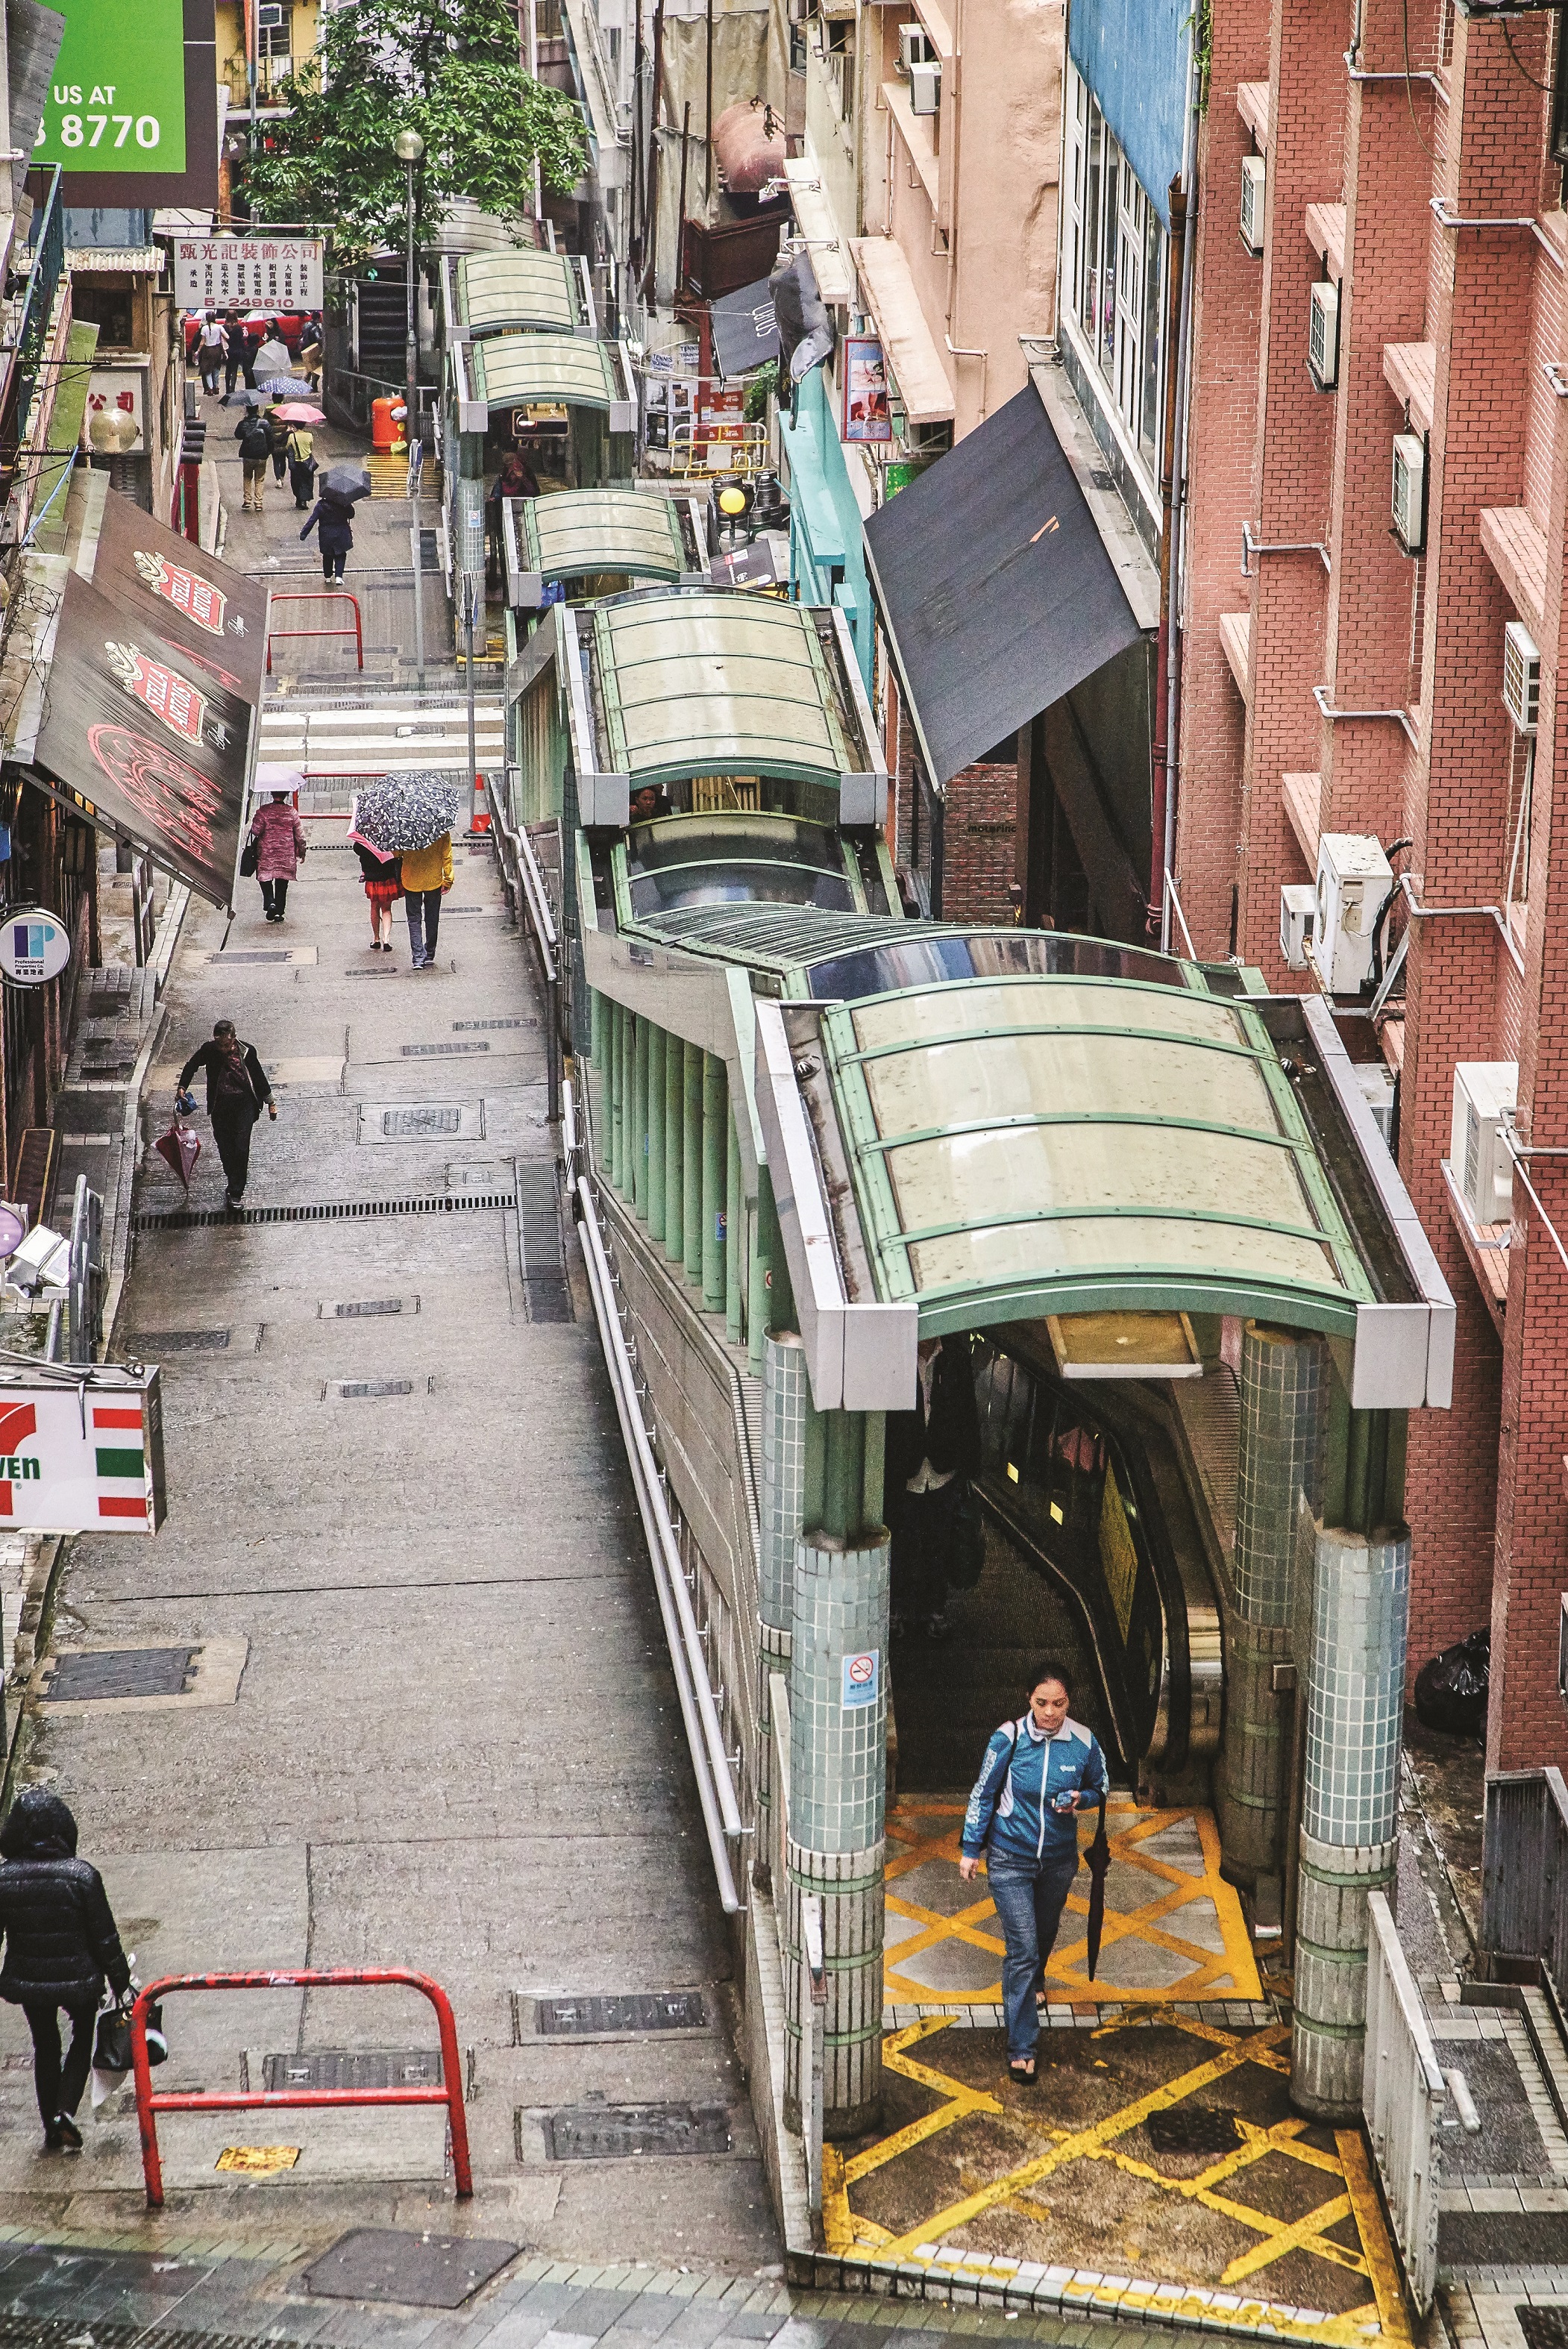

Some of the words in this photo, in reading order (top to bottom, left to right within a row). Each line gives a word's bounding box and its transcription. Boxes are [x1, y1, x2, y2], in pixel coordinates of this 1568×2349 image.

[54, 85, 83, 104] US
[88, 85, 116, 104] AT
[60, 114, 160, 148] 8770
[170, 570, 191, 609] STELLA
[192, 583, 213, 623] ARTOIS
[145, 665, 169, 712] STELLA
[168, 681, 192, 730] ARTOIS
